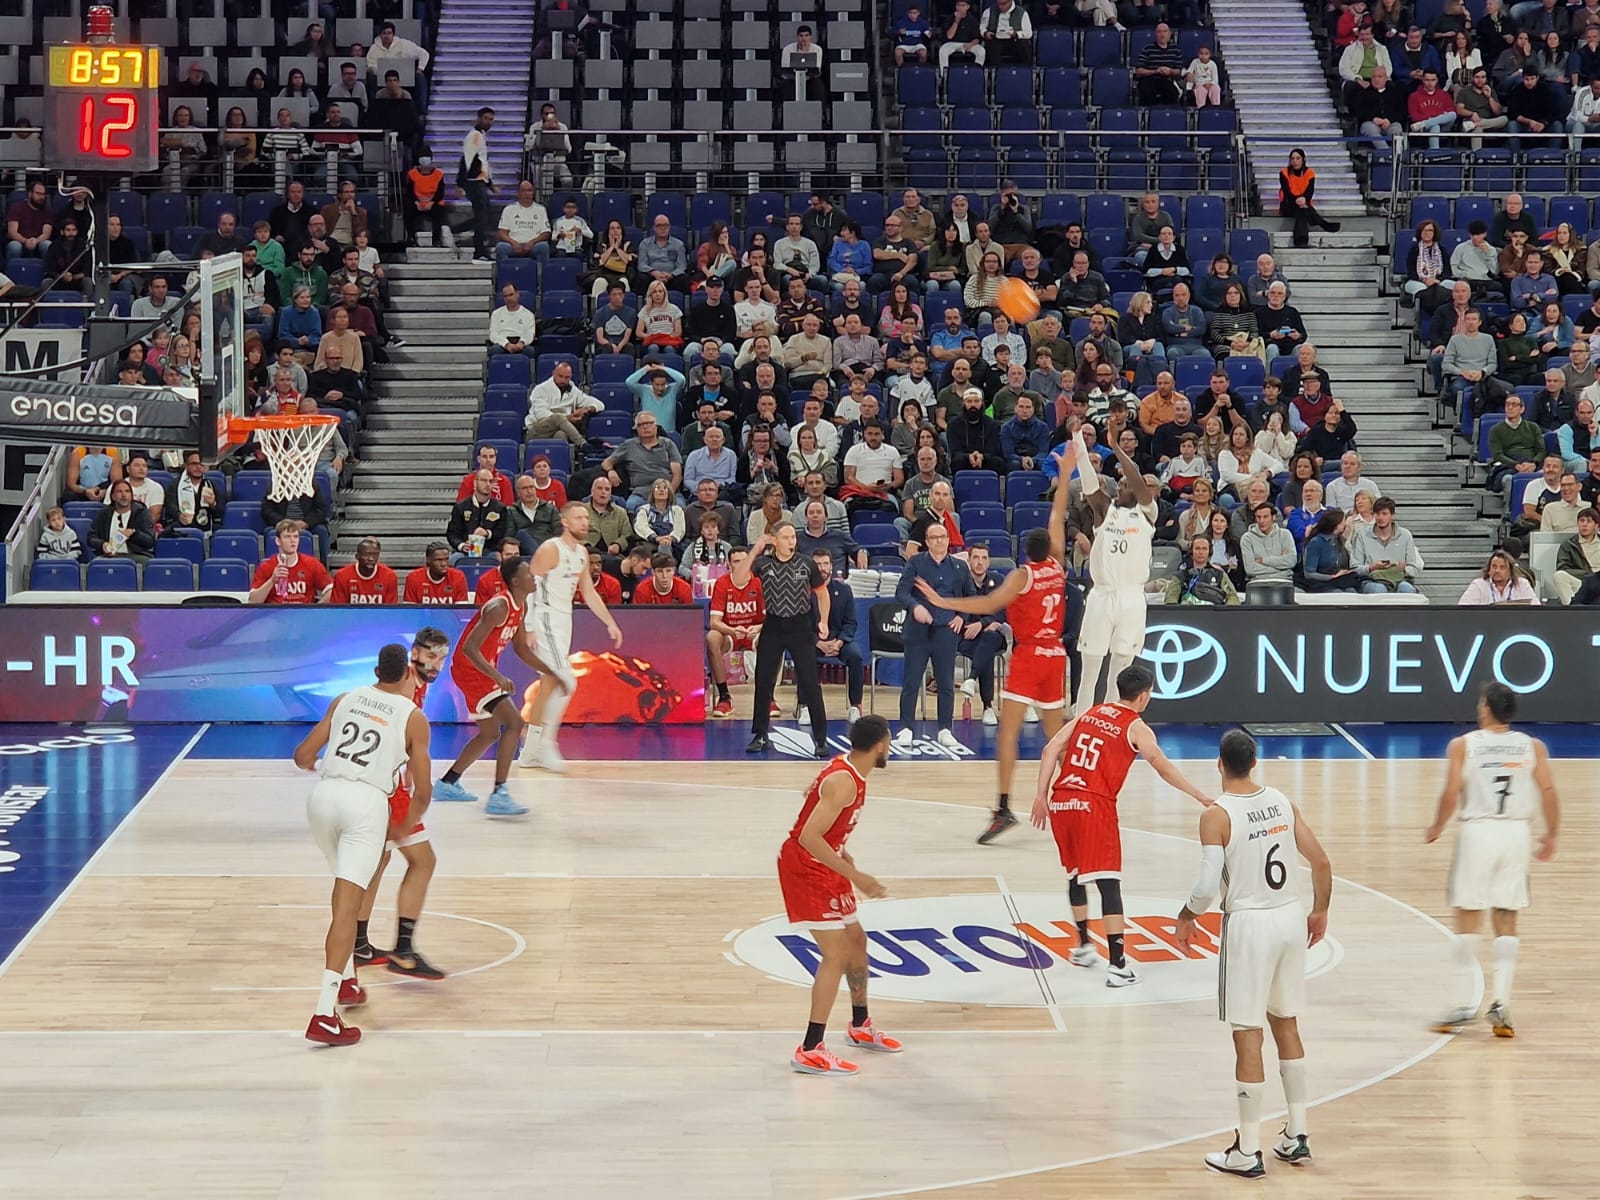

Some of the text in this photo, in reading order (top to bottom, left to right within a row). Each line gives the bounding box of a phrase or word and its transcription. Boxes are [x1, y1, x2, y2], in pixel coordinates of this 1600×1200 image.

[71, 50, 142, 83] 8:57
[82, 97, 135, 156] 12
[11, 396, 138, 426] endesa
[1110, 540, 1128, 554] 30
[726, 600, 757, 613] BAXI
[882, 622, 903, 633] Unic
[1257, 634, 1554, 694] NUEVO
[335, 721, 382, 768] 22
[1070, 732, 1104, 771] 55
[1492, 775, 1513, 814] 7
[1246, 805, 1282, 824] ABALDE
[1248, 824, 1289, 841] AUTOHERO
[1265, 843, 1287, 890] 6
